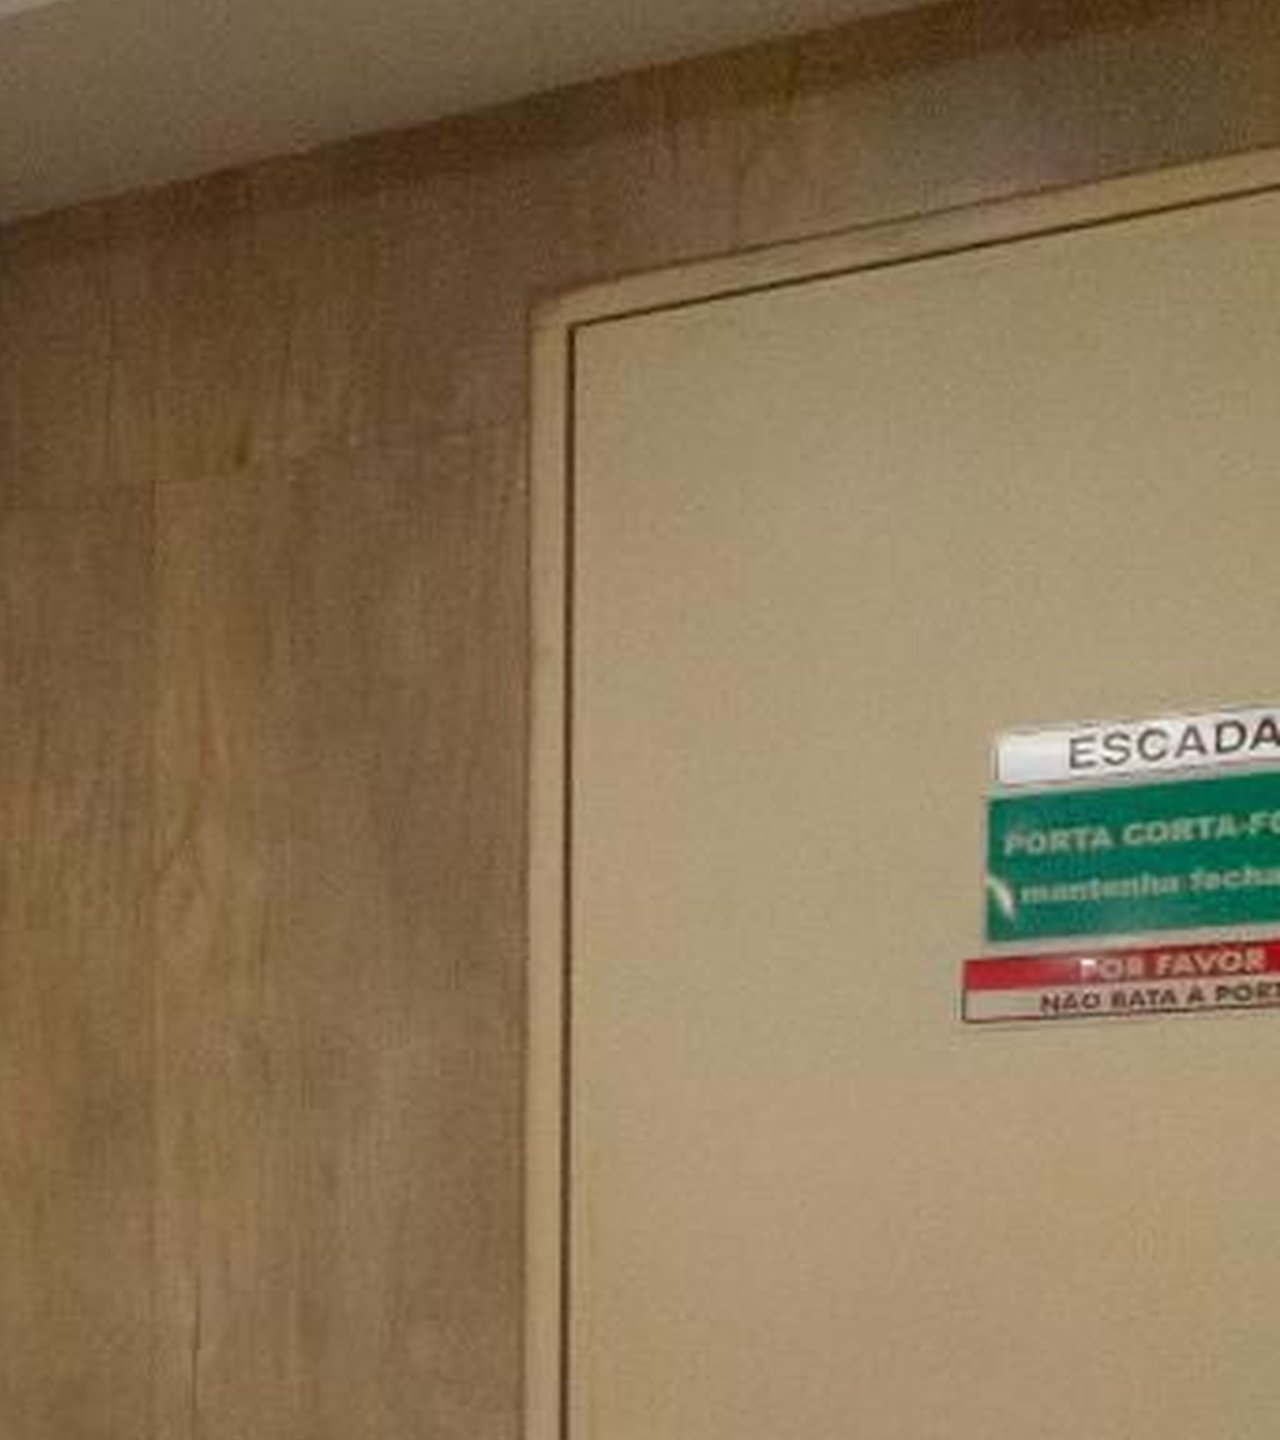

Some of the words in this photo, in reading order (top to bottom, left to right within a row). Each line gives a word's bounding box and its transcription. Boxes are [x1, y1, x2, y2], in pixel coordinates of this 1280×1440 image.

[1003, 824, 1114, 856] PORTA
[1122, 810, 1280, 847] CORTA-FO
[1020, 872, 1181, 904] mantenha
[1189, 864, 1280, 891] fecha
[1080, 957, 1146, 980] POR
[1156, 948, 1267, 977] FAVOR
[1040, 989, 1101, 1014] NÃO
[1111, 987, 1178, 1009] BATA
[1215, 980, 1280, 1003] PORT
